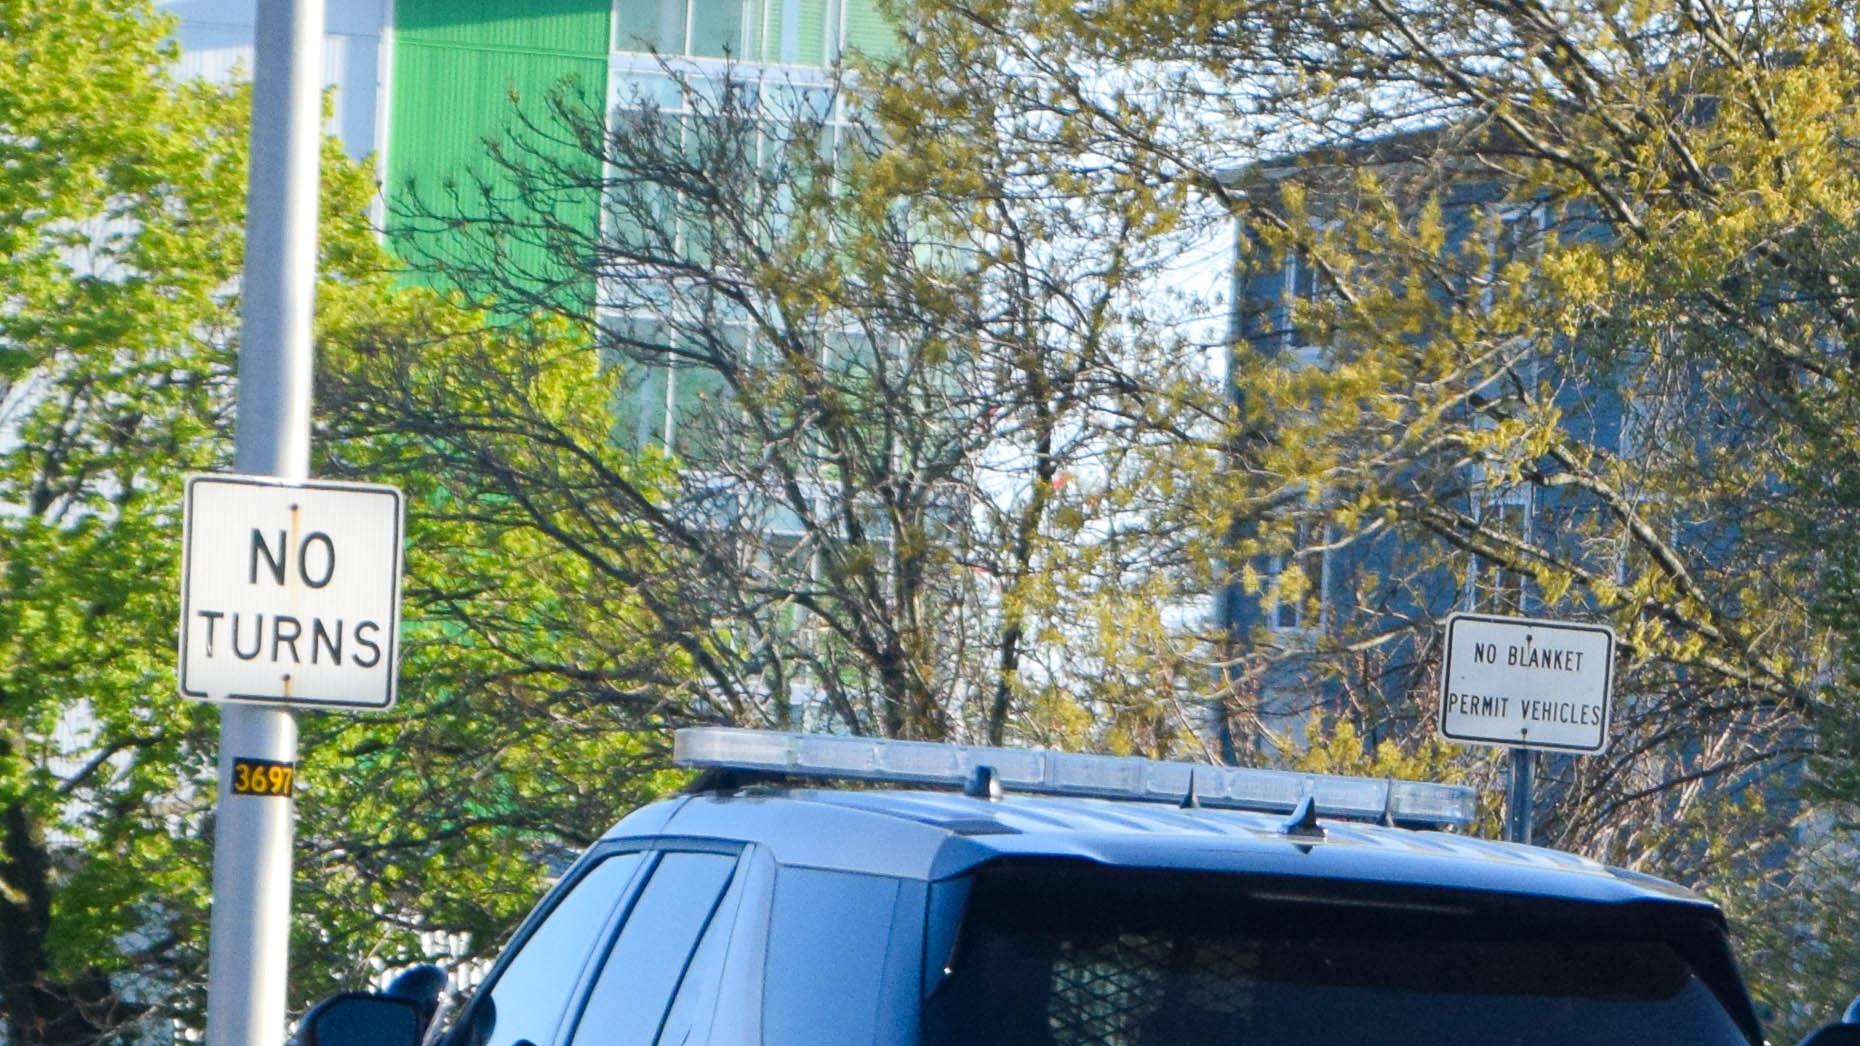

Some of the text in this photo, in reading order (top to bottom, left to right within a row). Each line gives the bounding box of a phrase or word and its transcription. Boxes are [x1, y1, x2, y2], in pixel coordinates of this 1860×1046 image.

[250, 528, 335, 588] NO
[198, 610, 381, 668] TURNS
[1474, 642, 1583, 671] NO BLANKET
[1449, 693, 1600, 726] PERMIT VEHICLES
[234, 763, 293, 793] 3697
